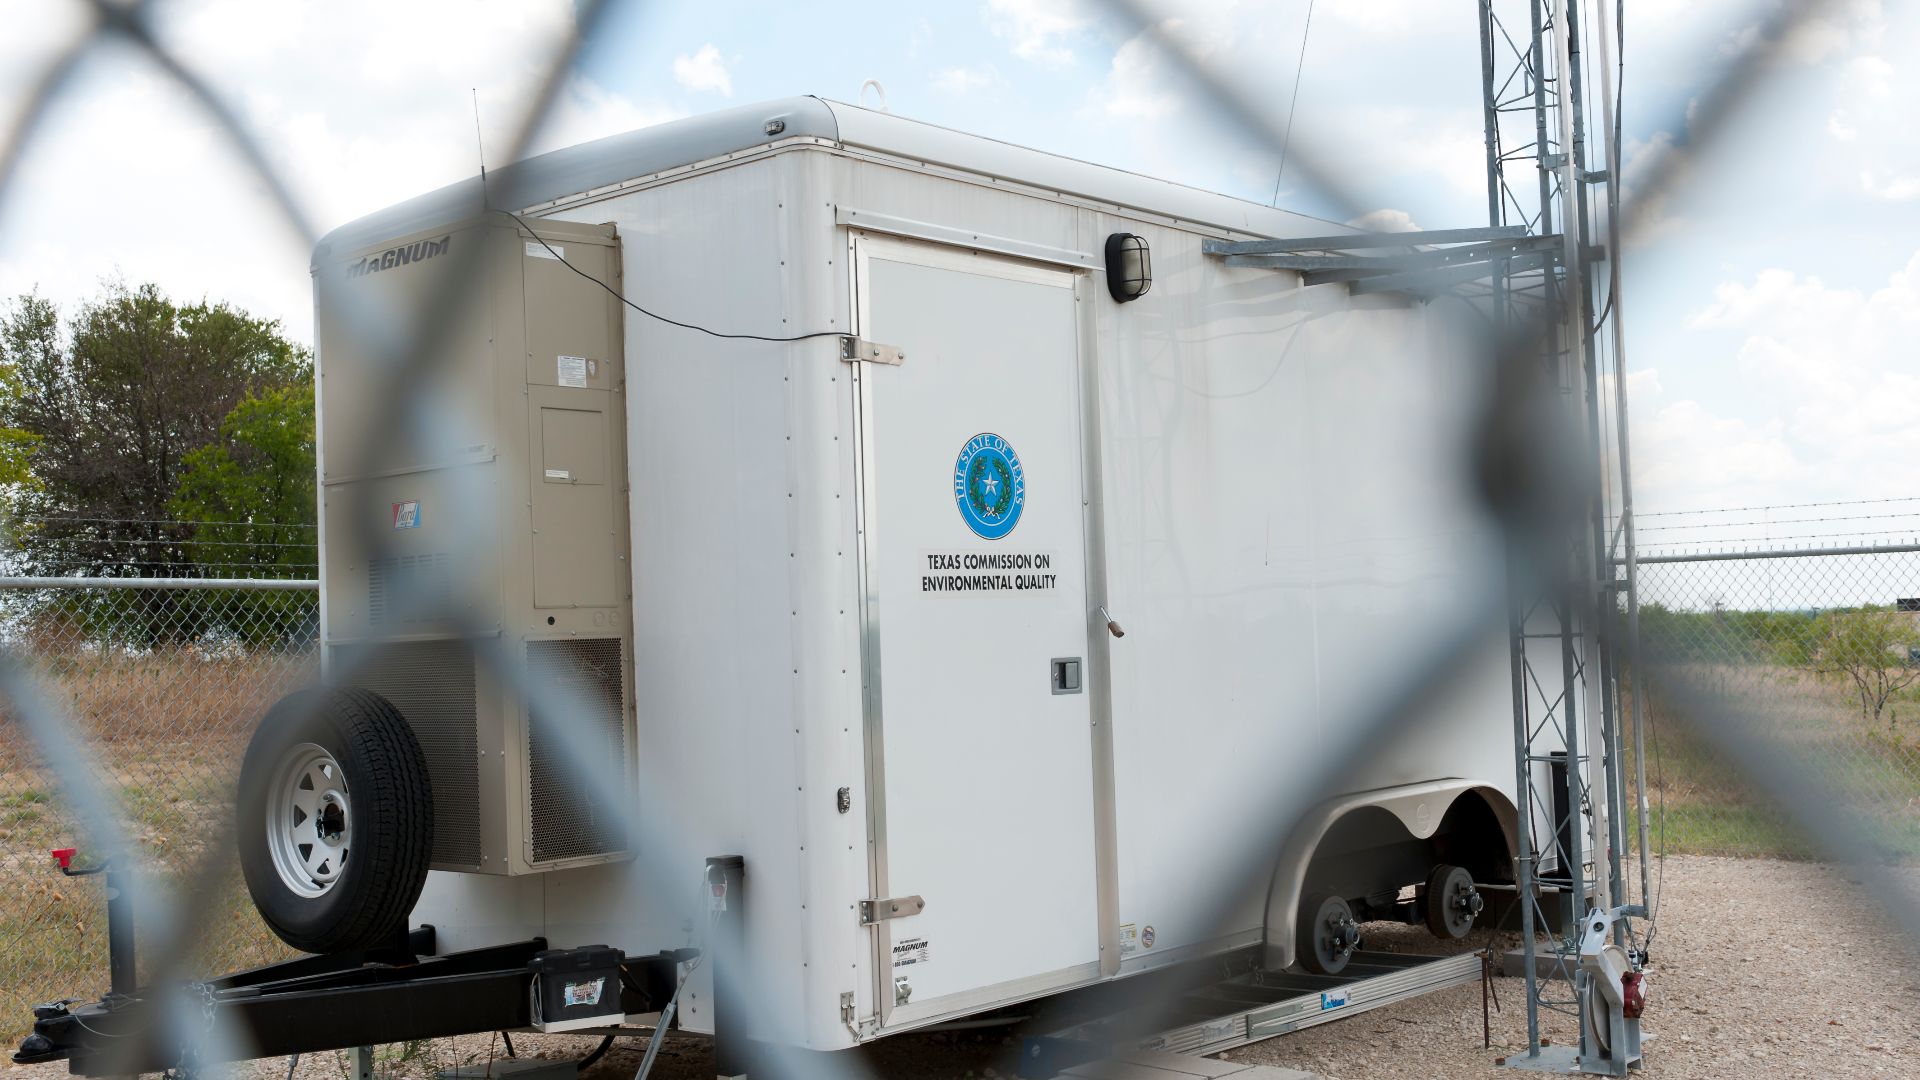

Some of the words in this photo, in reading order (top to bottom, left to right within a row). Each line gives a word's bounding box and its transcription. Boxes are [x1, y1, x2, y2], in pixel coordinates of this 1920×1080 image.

[346, 235, 451, 280] MAGNUM
[956, 469, 965, 499] THE
[961, 435, 991, 464] STATE
[995, 438, 1010, 453] OF
[1010, 453, 1024, 504] TEXAS
[928, 554, 961, 570] TEXAS
[964, 554, 1032, 570] COMMISSION
[1034, 553, 1050, 569] ON
[922, 576, 1013, 592] ENVIRONMENTAL
[1015, 574, 1057, 591] QUALITY
[893, 941, 928, 954] MAGNUM
